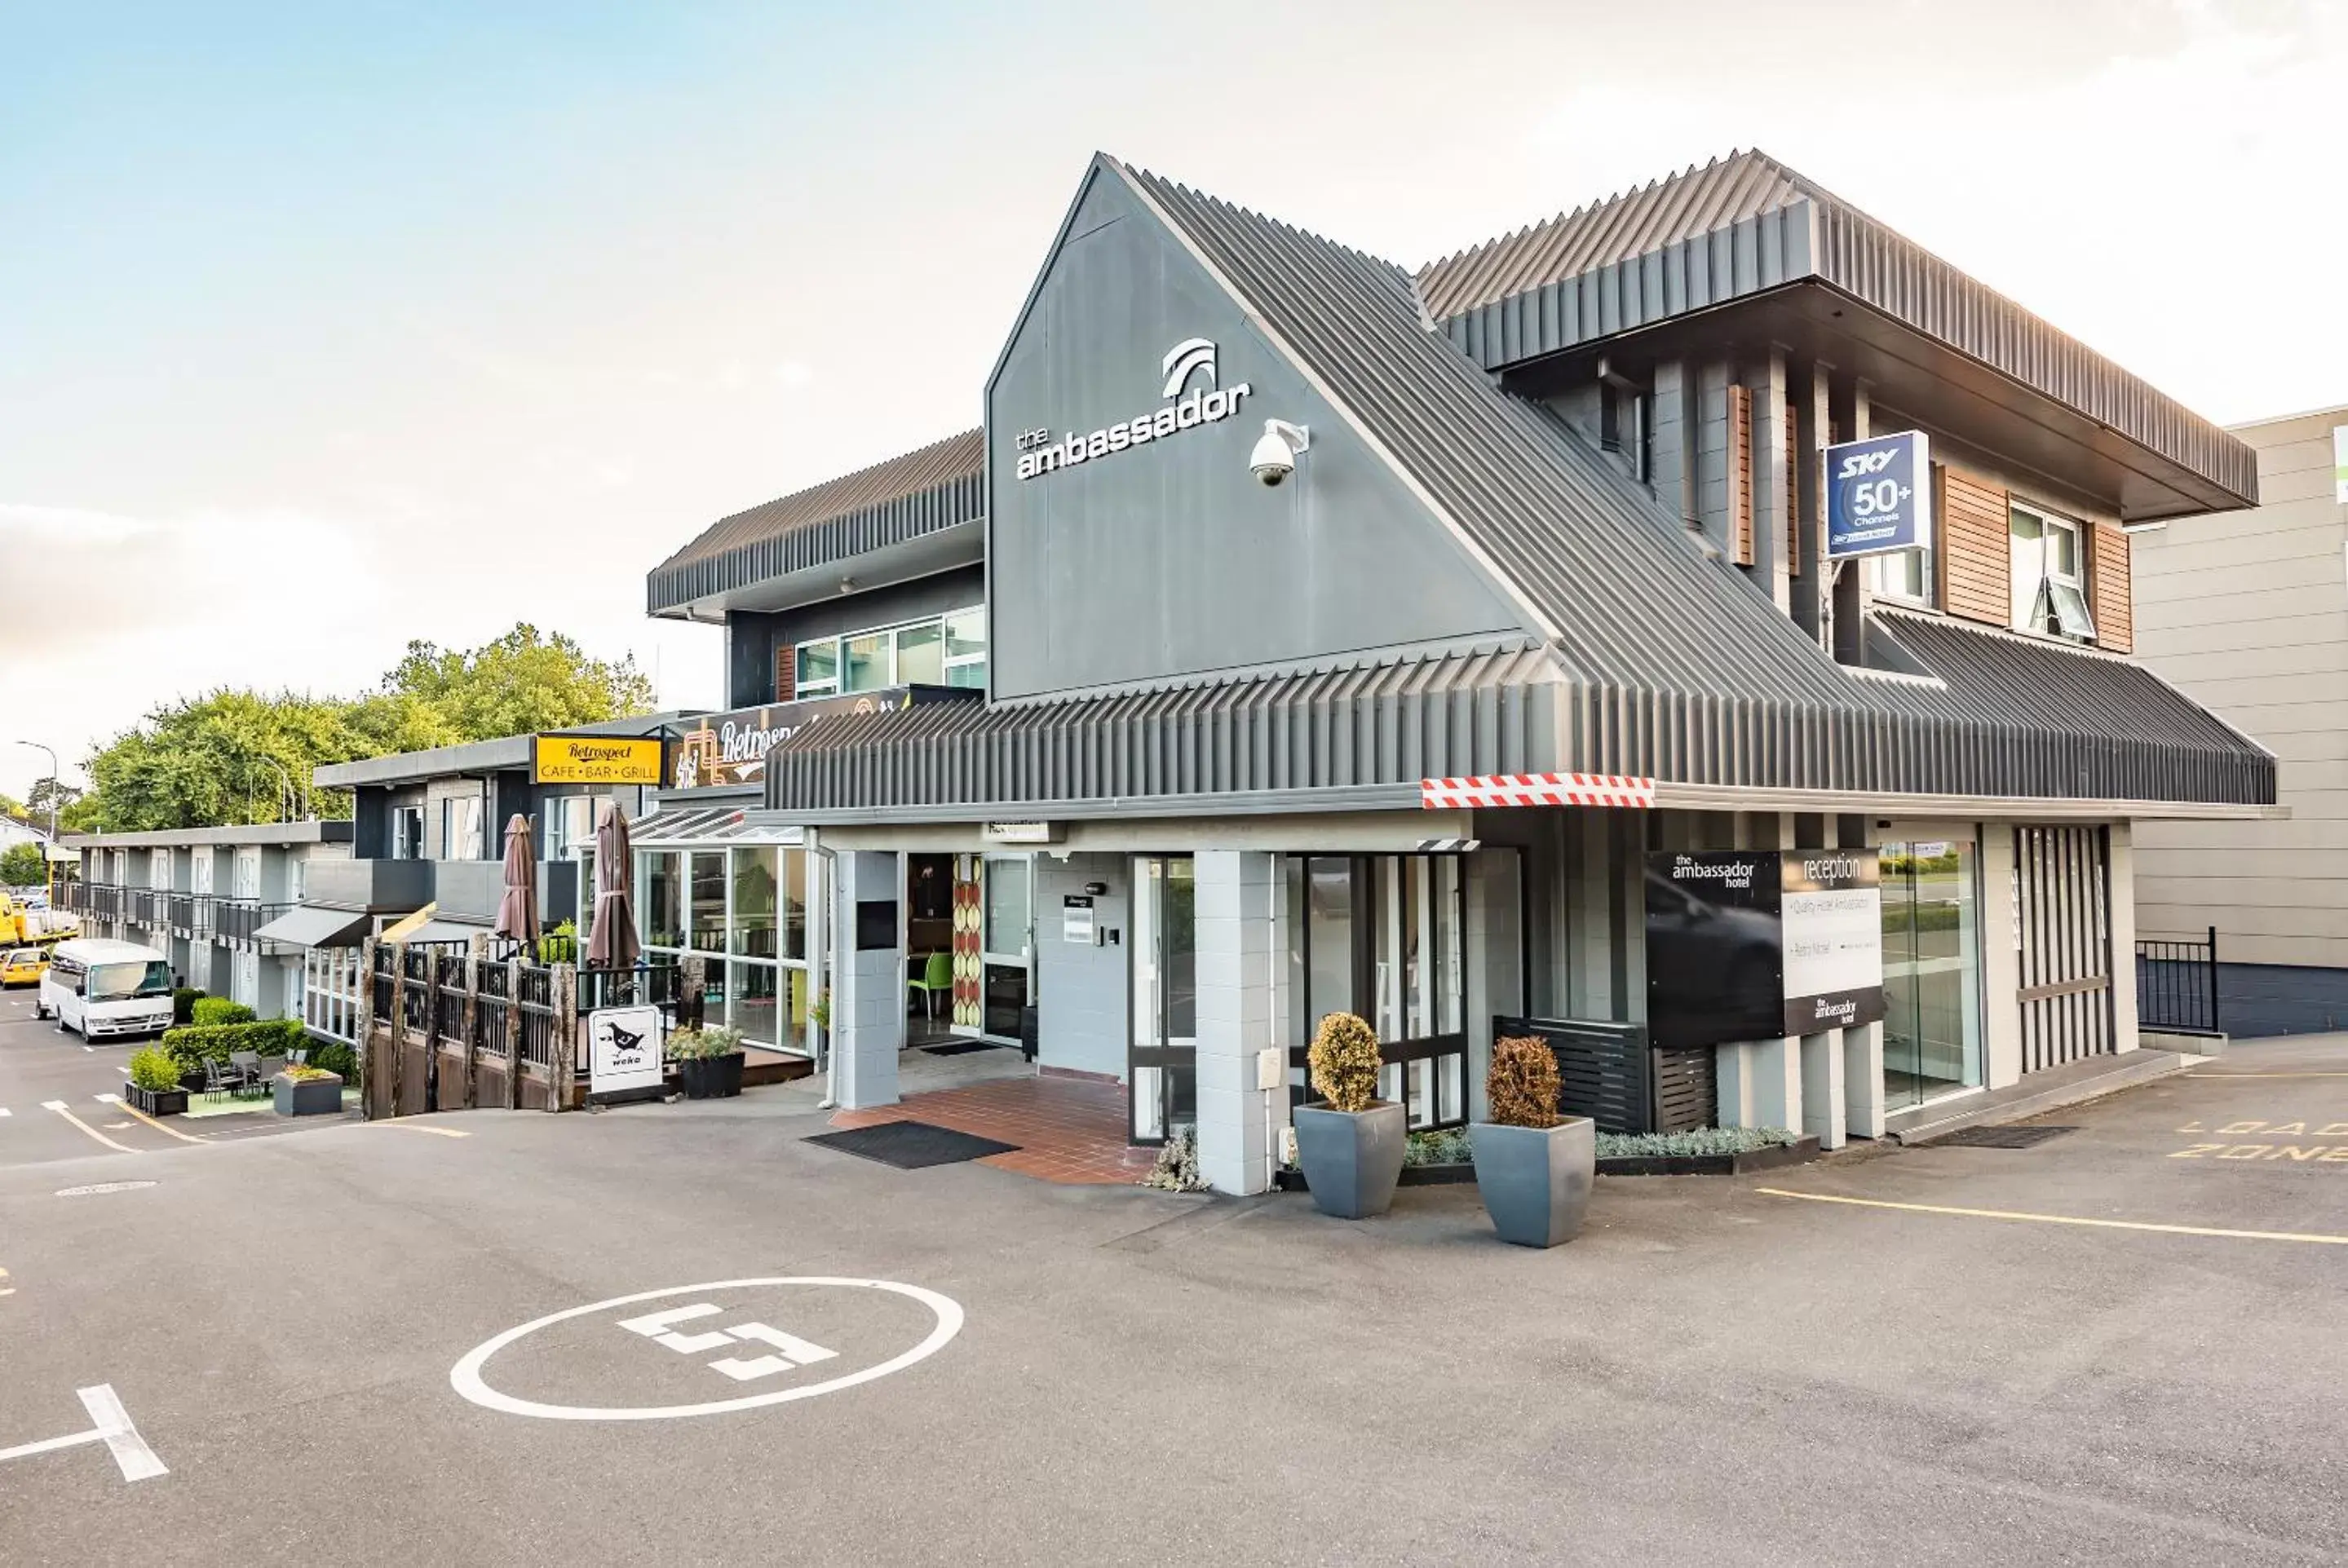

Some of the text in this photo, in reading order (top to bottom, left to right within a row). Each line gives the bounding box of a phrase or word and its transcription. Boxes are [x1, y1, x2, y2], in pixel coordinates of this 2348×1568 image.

[1015, 427, 1048, 449] the
[1017, 382, 1251, 479] ambassador
[1837, 448, 1899, 479] SKY
[1854, 479, 1912, 515] 50+
[1855, 512, 1899, 527] Channels
[568, 743, 631, 762] Retrospect
[541, 765, 656, 779] CAFE BAR GRILL
[1673, 860, 1754, 878] ambassador
[1676, 855, 1692, 864] the
[1804, 852, 1860, 886] reception
[1726, 877, 1749, 888] hotel
[1815, 999, 1856, 1018] ambassador
[613, 1056, 641, 1067] weka
[2166, 1143, 2348, 1162] ZONE
